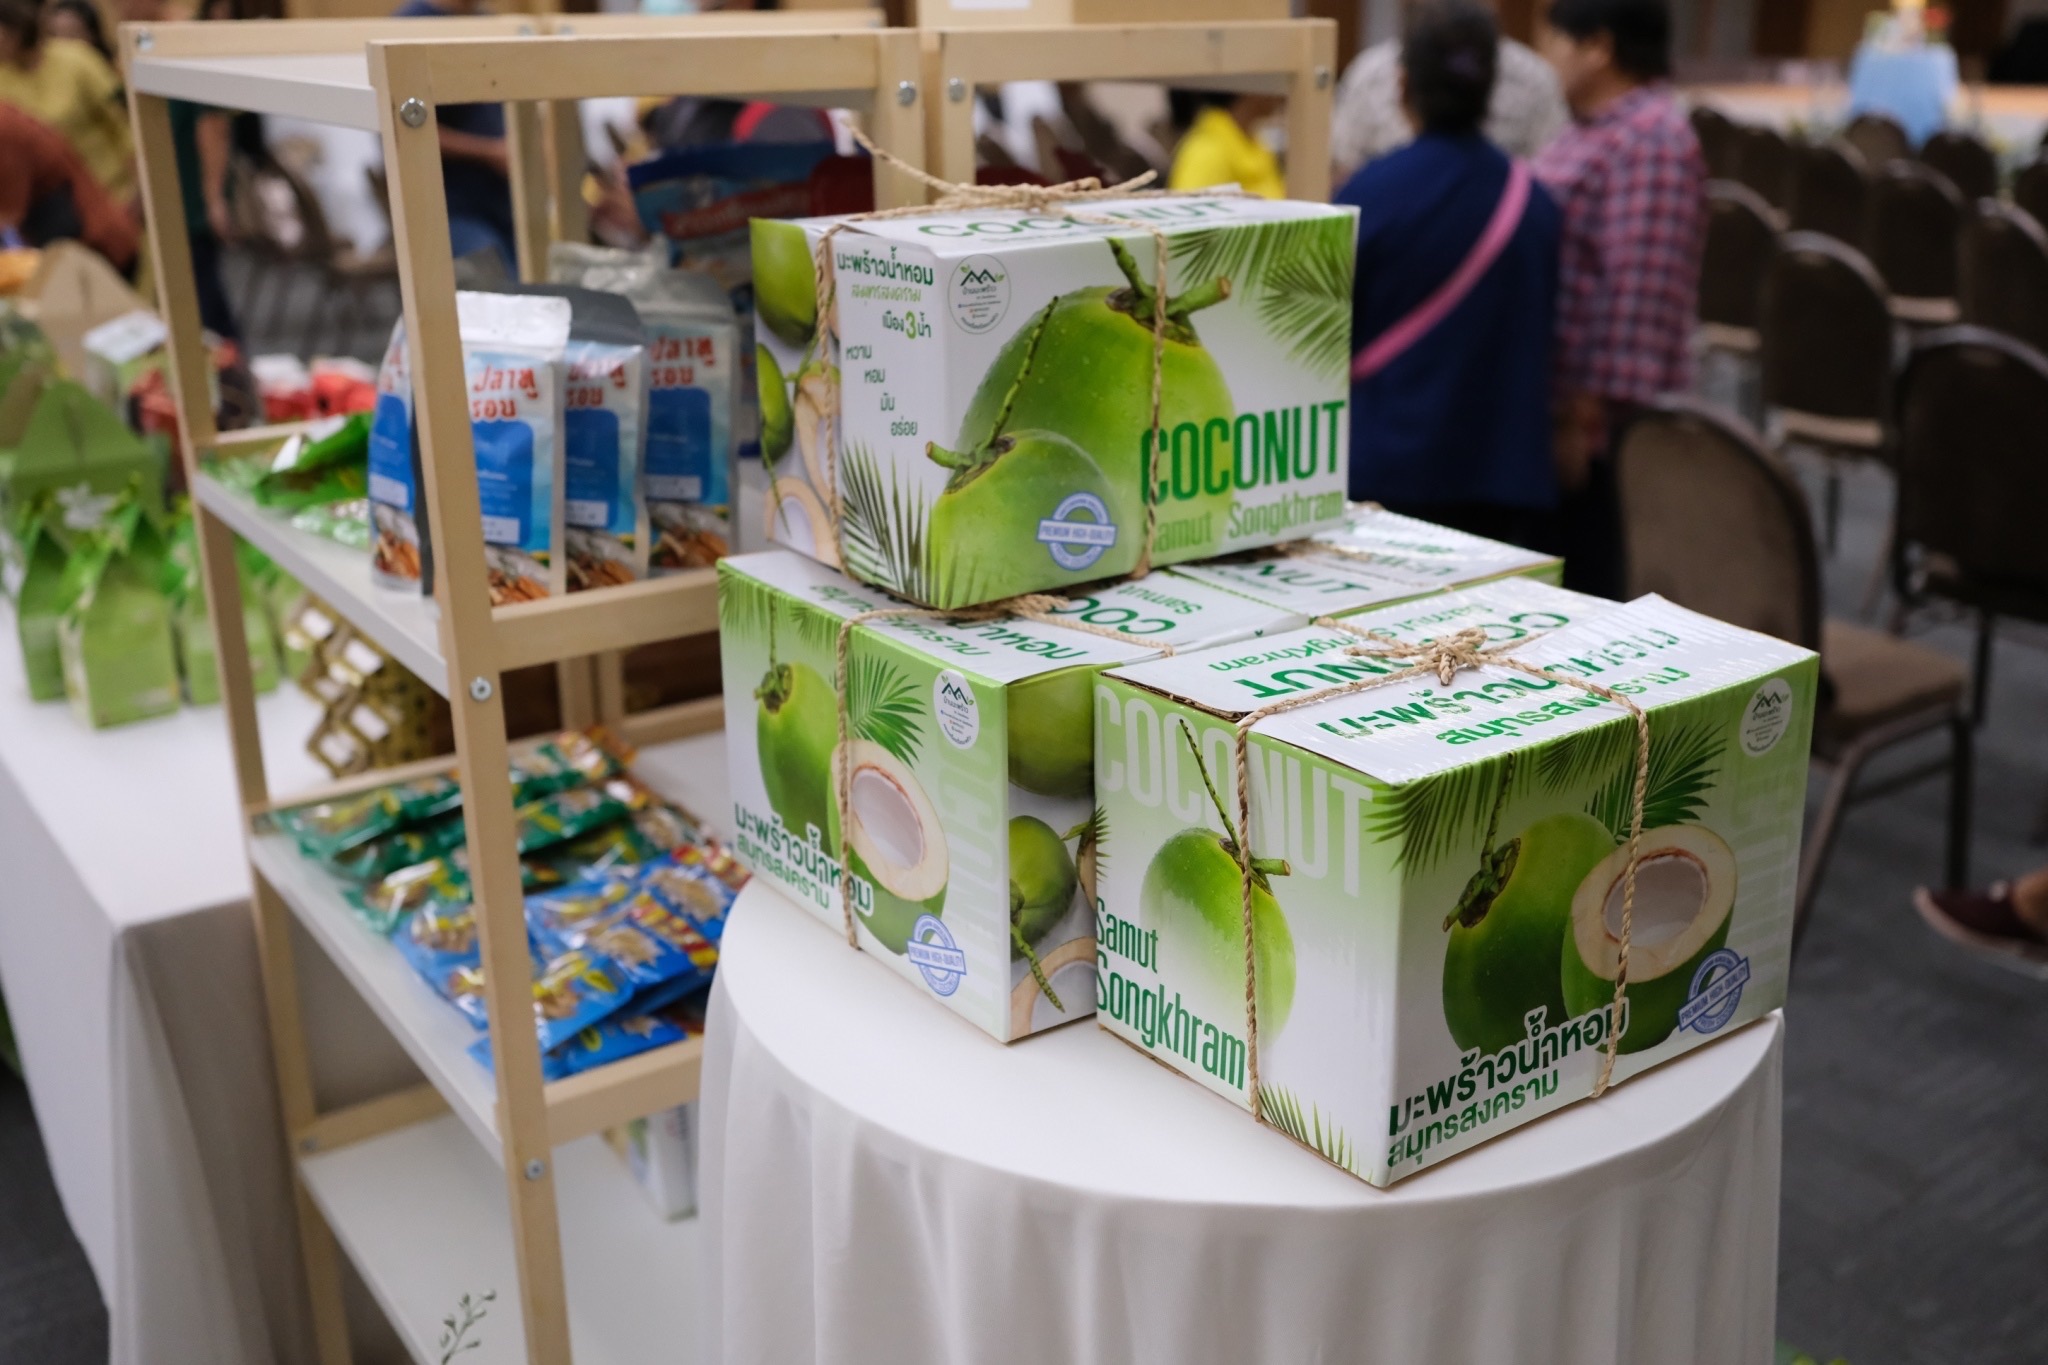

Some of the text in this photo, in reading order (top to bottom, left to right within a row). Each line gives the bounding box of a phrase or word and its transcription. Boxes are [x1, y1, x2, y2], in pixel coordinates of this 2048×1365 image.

[837, 246, 933, 286] มะพร้าวน้ำหอม
[1141, 401, 1345, 505] COCONUT
[1229, 490, 1343, 539] Songkhram
[1208, 626, 1397, 672] Sngkhram
[1233, 612, 1571, 699] CONUT
[1097, 685, 1373, 897] COCONUT
[1097, 897, 1159, 974] Samut
[1097, 949, 1246, 1090] Songkhram
[1389, 1003, 1626, 1136] มะพร้าวน้ำหอม
[1387, 1069, 1559, 1167] สมุทรสงคราม
